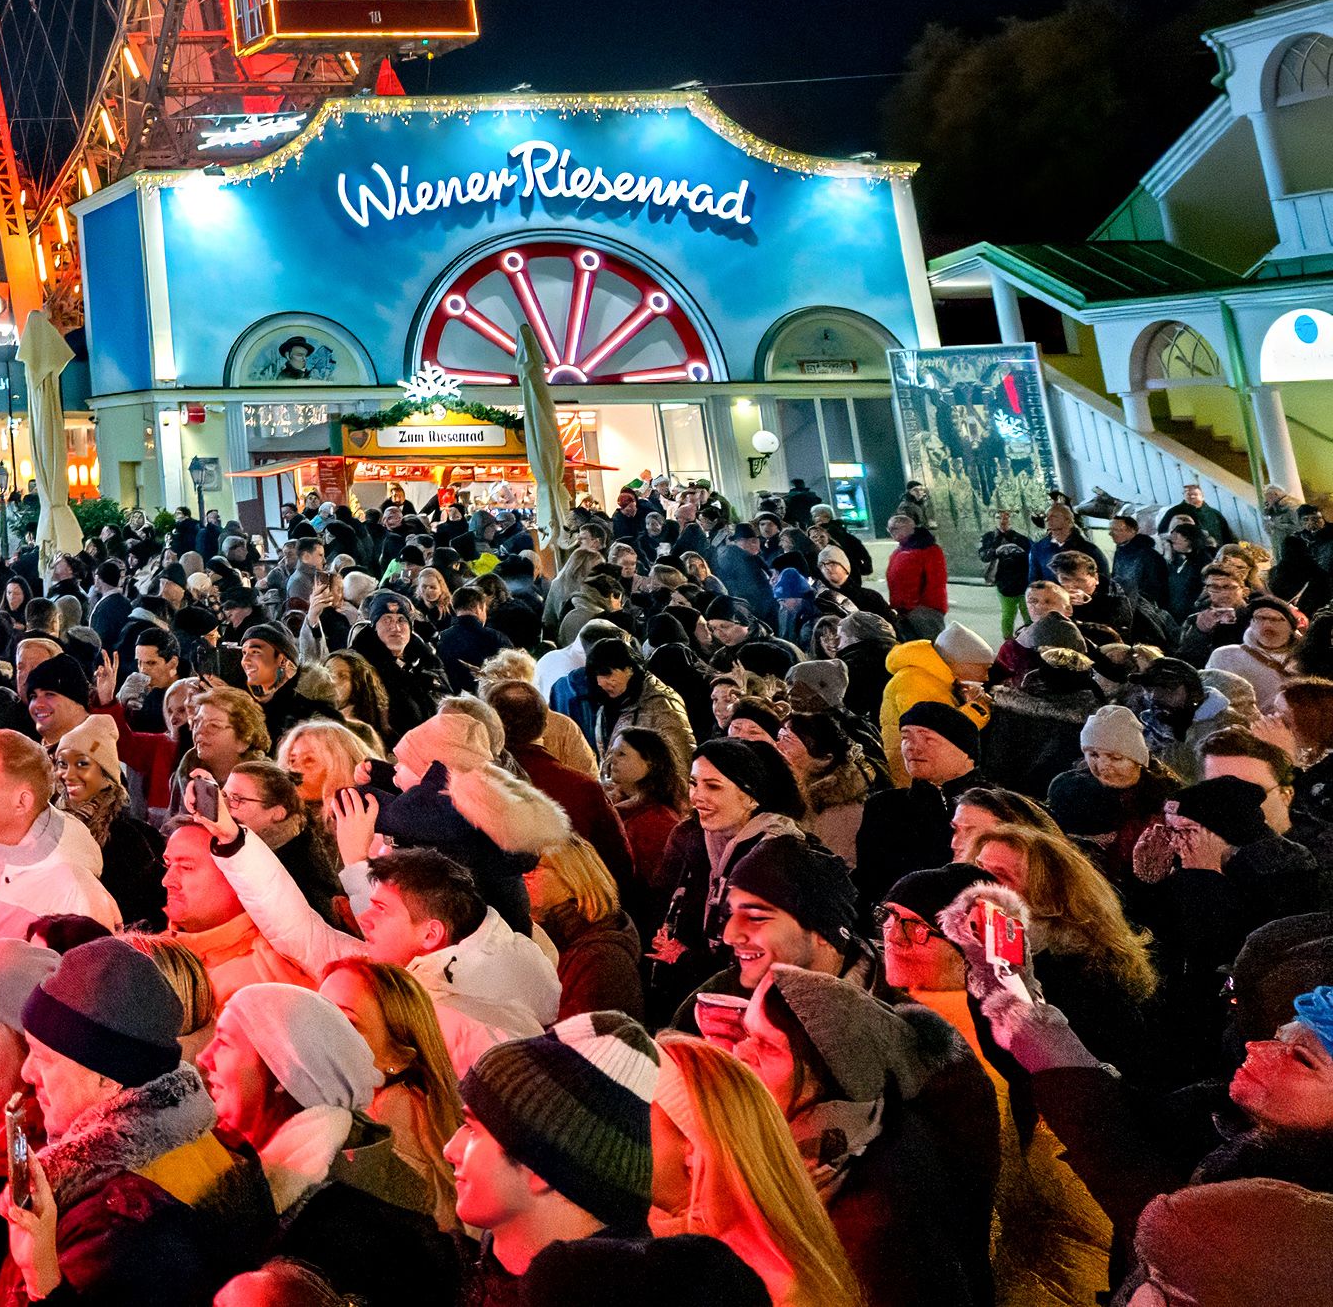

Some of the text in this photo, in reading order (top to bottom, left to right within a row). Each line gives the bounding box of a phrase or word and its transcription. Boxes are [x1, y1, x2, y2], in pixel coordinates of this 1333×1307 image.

[337, 140, 751, 228] Wiener Riesenrad
[398, 430, 485, 443] Zum Riesenrad
